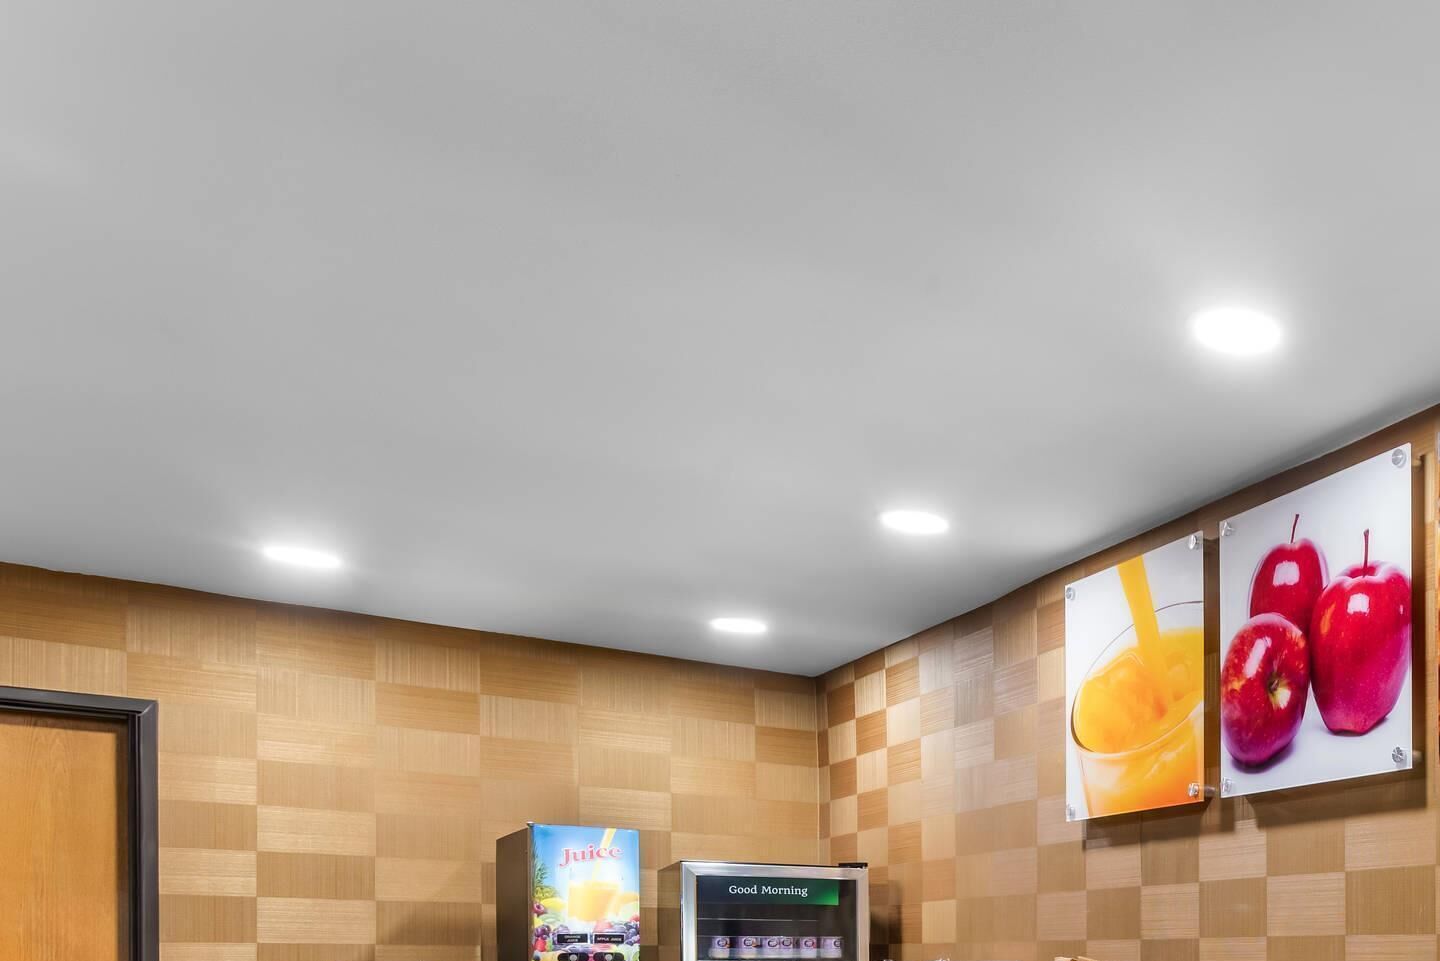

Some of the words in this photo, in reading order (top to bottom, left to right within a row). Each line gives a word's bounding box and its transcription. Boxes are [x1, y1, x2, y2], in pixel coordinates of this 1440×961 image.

[559, 844, 623, 868] Juice
[728, 885, 758, 895] Good
[761, 886, 808, 897] Morning
